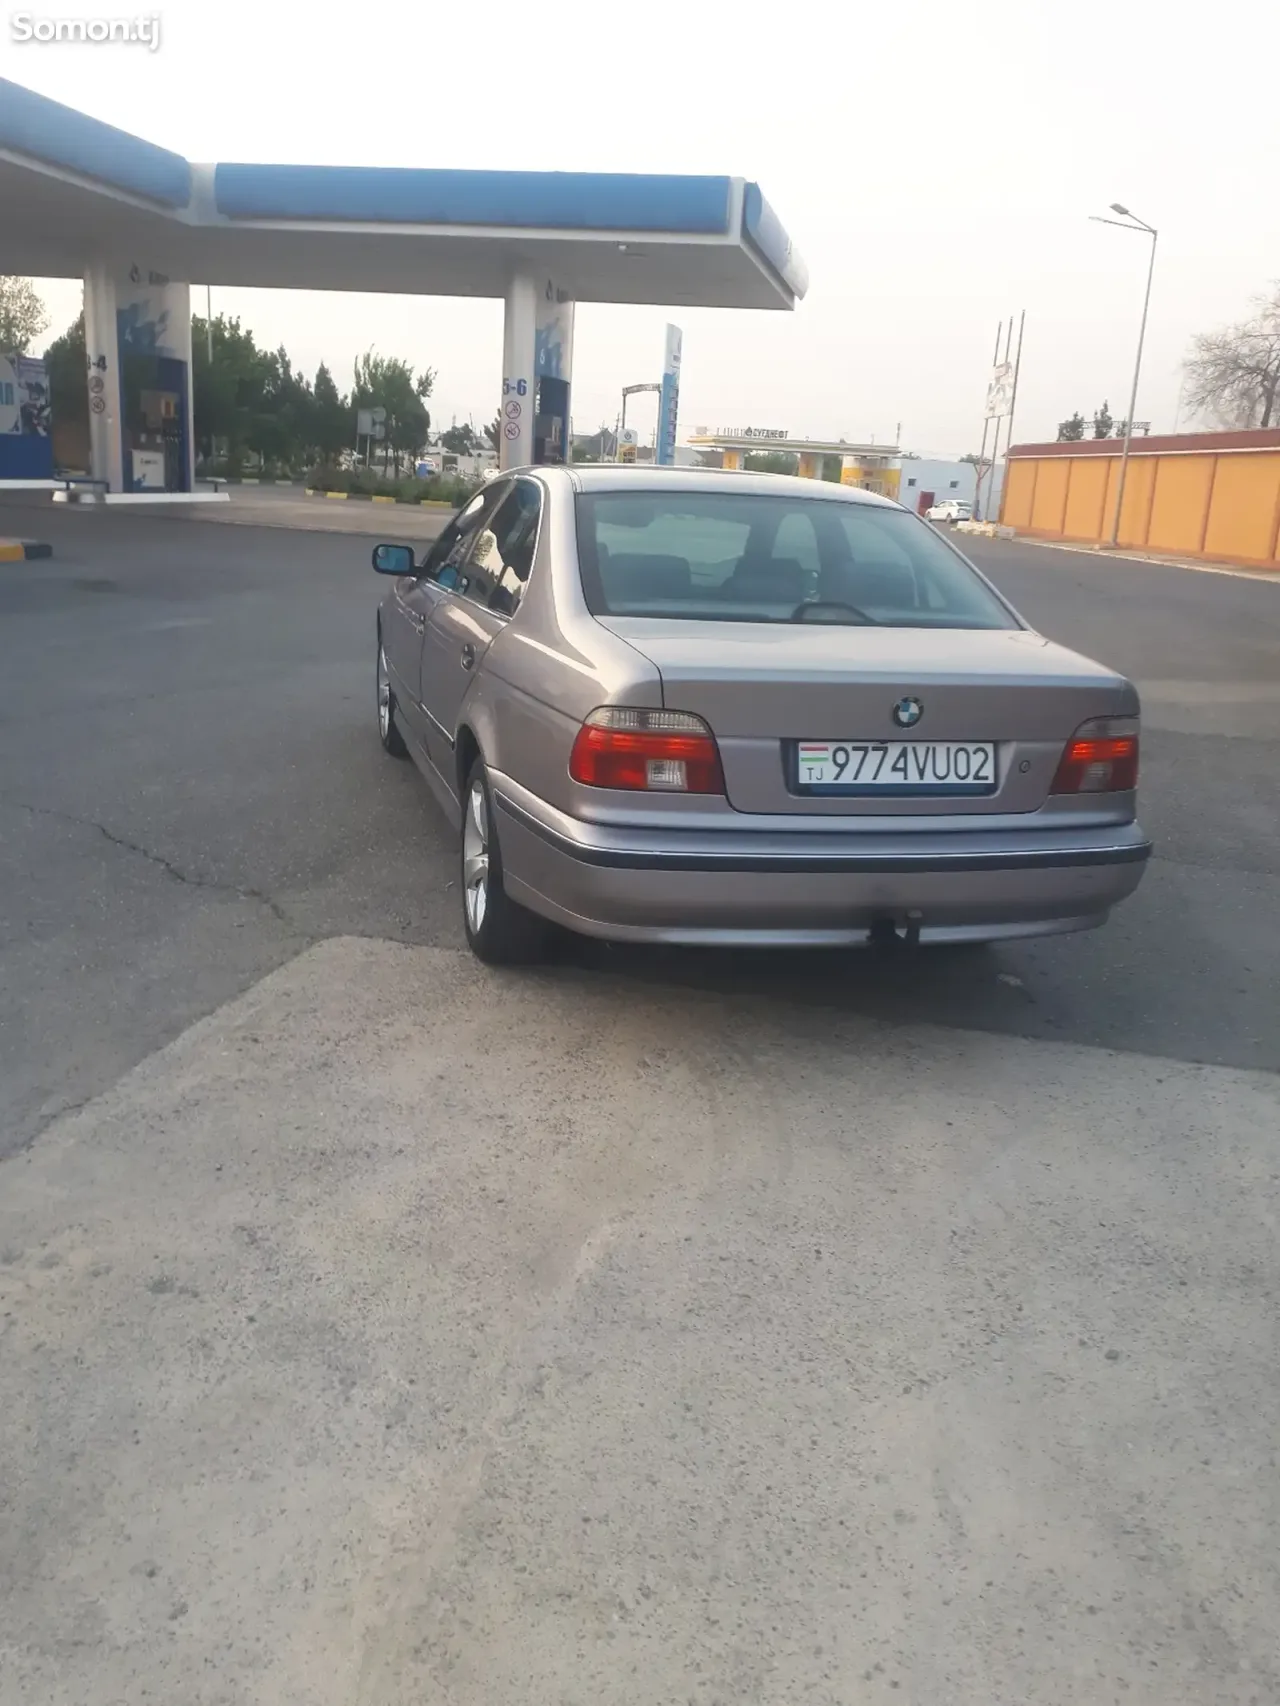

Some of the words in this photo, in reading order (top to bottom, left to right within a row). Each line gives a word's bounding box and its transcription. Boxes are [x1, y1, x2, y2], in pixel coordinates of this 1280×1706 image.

[503, 378, 527, 396] 5-6
[832, 746, 989, 781] 9774VU02
[807, 768, 823, 781] TJ
